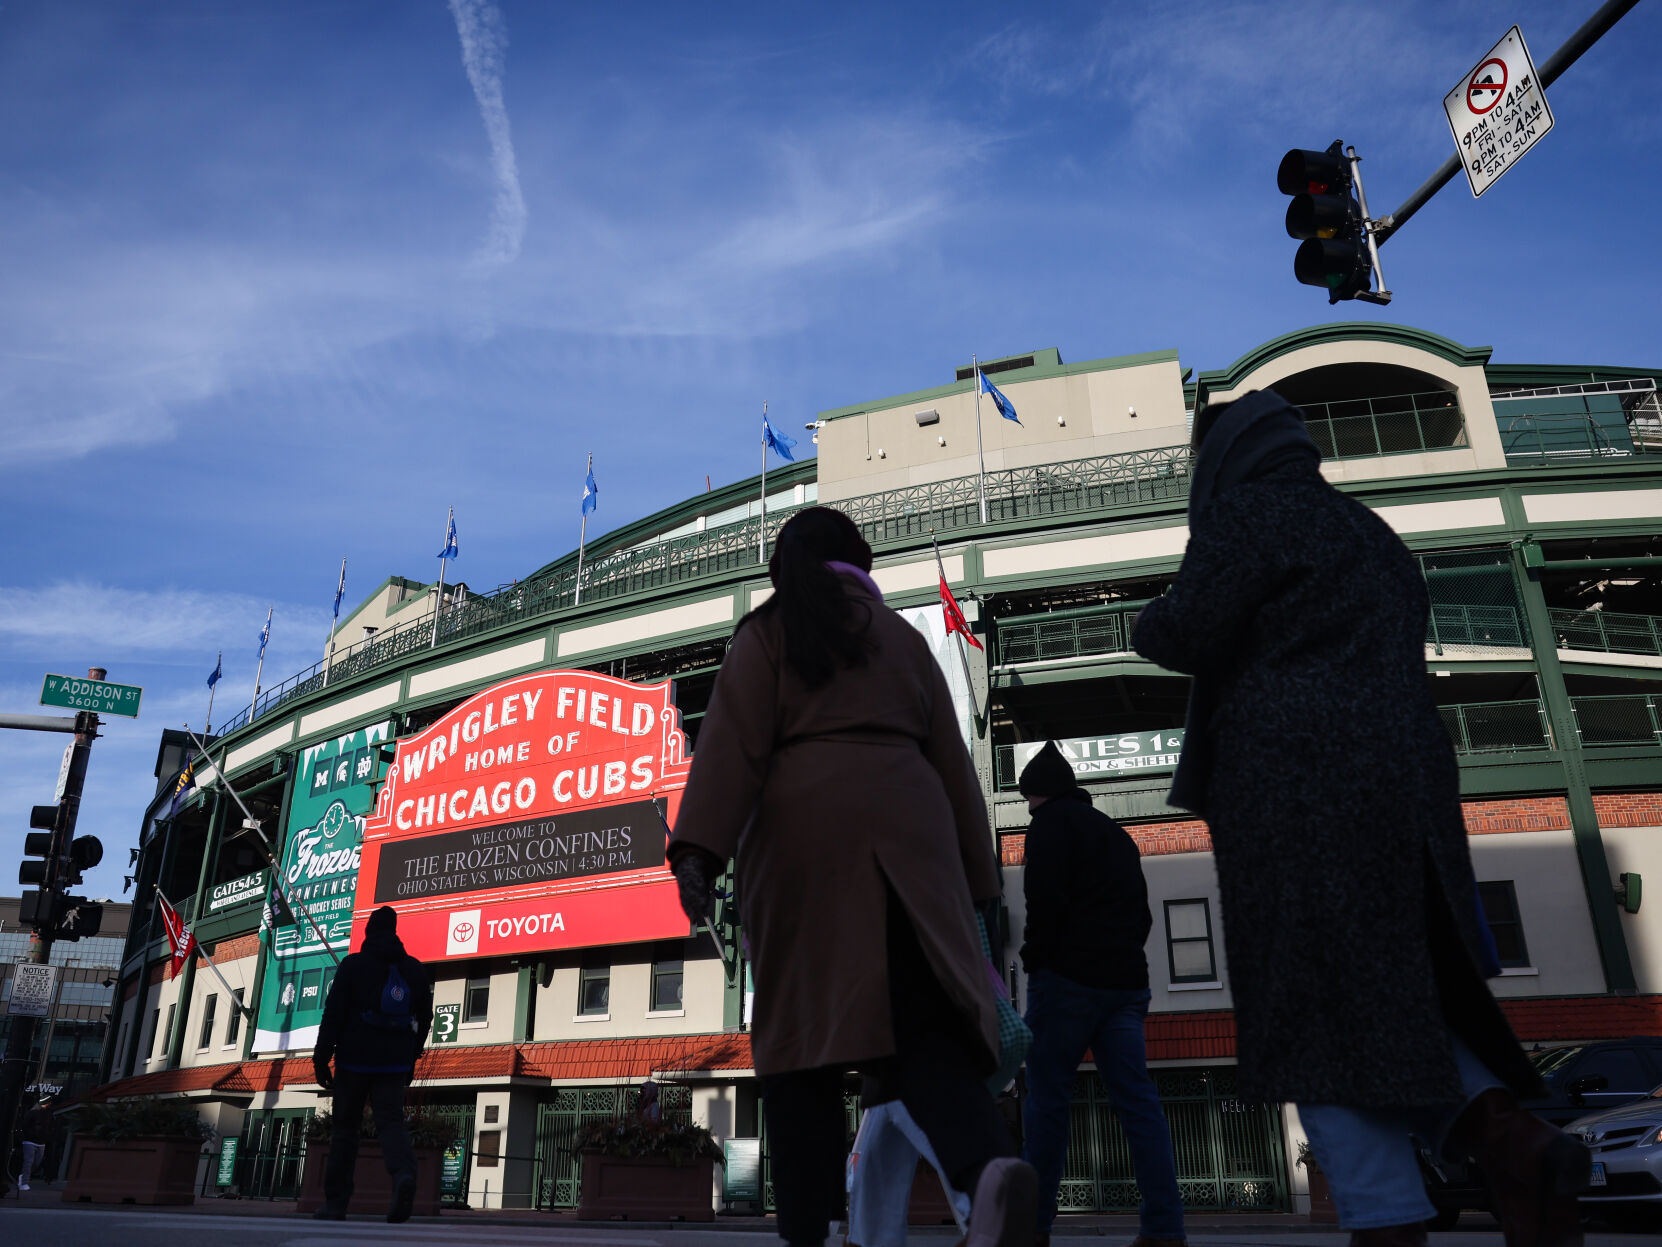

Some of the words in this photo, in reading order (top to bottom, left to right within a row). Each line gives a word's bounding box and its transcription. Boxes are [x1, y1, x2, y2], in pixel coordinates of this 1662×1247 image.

[1463, 118, 1489, 149] 9PM
[1489, 105, 1503, 122] TO
[1505, 75, 1533, 109] 4AM
[1471, 143, 1498, 175] 9PM
[1498, 131, 1512, 148] TO
[1515, 101, 1542, 134] 4AM
[1478, 131, 1496, 151] FRI
[1503, 102, 1523, 126] SAT
[49, 680, 57, 690] W
[60, 679, 123, 701] ADDISON
[125, 691, 139, 701] ST
[67, 696, 99, 708] 3600
[106, 702, 114, 711] N
[403, 688, 544, 784] WRIGLEY
[556, 686, 656, 737] FIELD
[1150, 733, 1162, 752] 1
[1166, 738, 1180, 747] &
[465, 740, 531, 773] HOME
[547, 731, 581, 755] OF
[1124, 754, 1180, 768] SHEFFI
[395, 776, 537, 830] CHICAGO
[551, 755, 654, 803] CUBS
[472, 825, 535, 847] WELCOME
[539, 821, 556, 836] TO
[288, 836, 362, 884] Frozen
[404, 855, 440, 878] THE
[445, 843, 521, 874] FROZEN
[525, 826, 632, 861] CONFINES
[213, 878, 245, 899] GATES
[254, 872, 262, 886] 5
[397, 877, 428, 896] OHIO
[430, 874, 467, 892] STATE
[471, 869, 489, 885] VS.
[493, 858, 569, 883] WISCONSIN
[578, 853, 604, 871] 4:30
[608, 850, 636, 867] P.M.
[287, 877, 357, 904] CONFINES
[309, 900, 331, 915] HOCKEY
[331, 896, 351, 911] SERIES
[486, 912, 566, 939] TOYOTA
[22, 966, 50, 976] NOTICE
[302, 985, 318, 998] PSU
[437, 1005, 459, 1014] GATE
[437, 1014, 454, 1035] 3
[38, 1083, 63, 1096] Way
